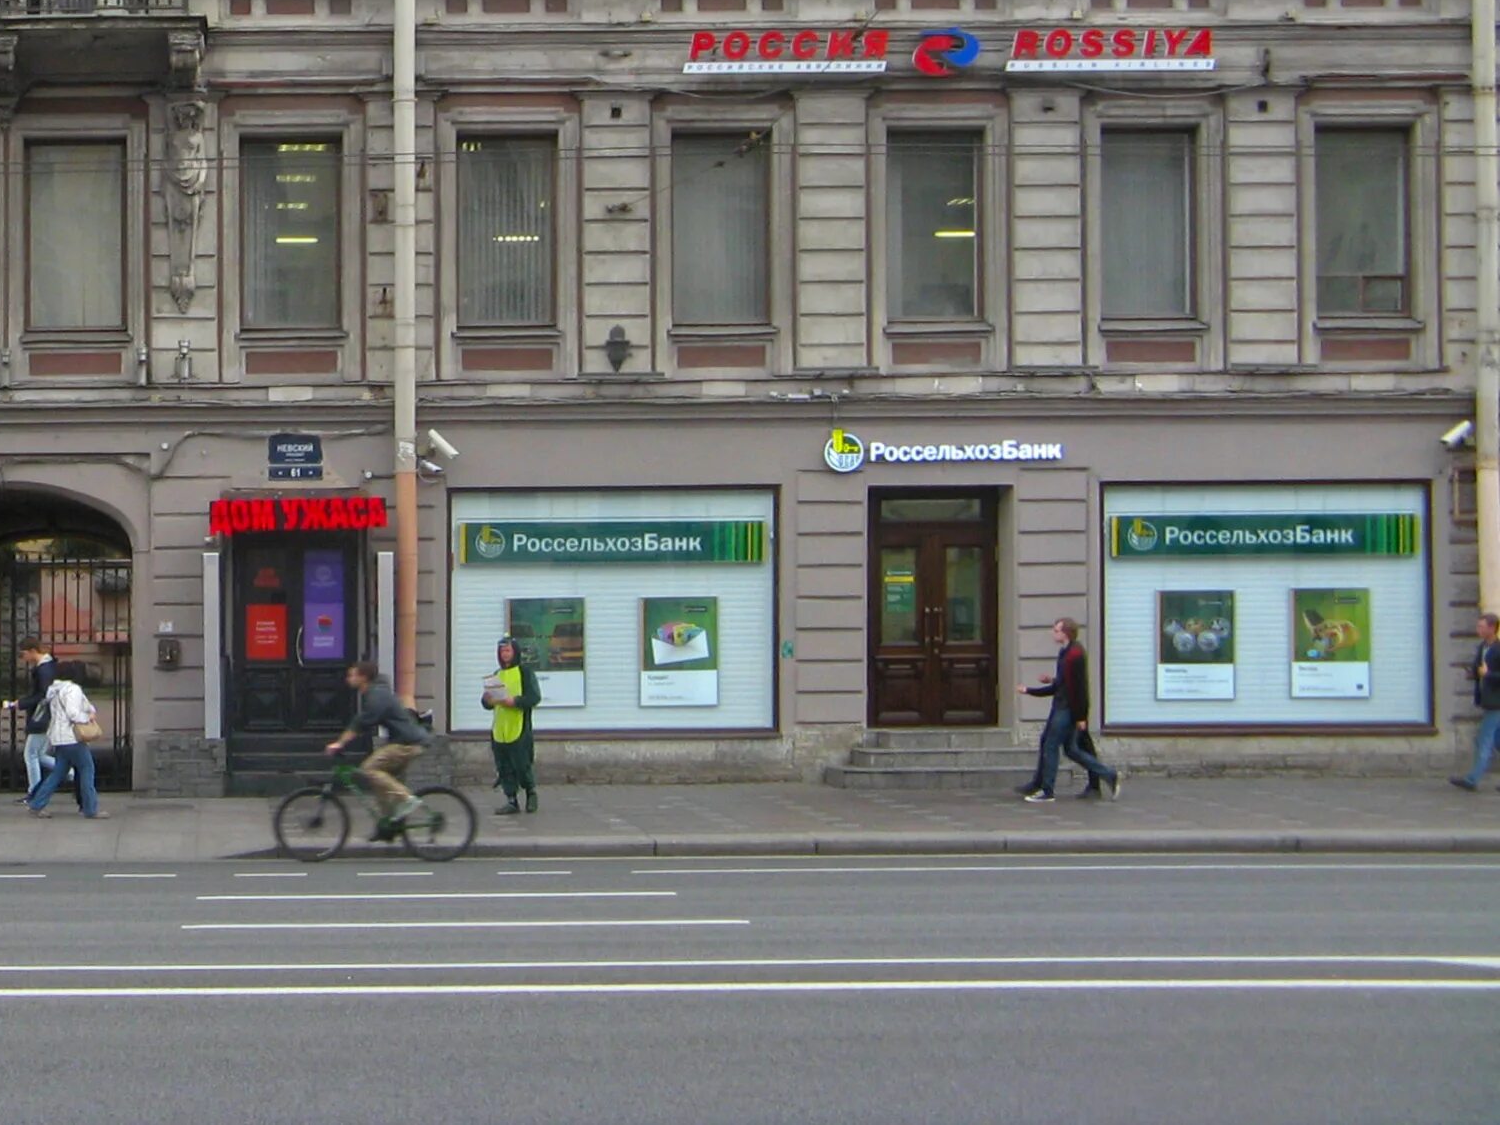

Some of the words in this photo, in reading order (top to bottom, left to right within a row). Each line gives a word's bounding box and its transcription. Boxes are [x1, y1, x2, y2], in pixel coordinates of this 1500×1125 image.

[689, 29, 890, 62] РОССИЯ
[1010, 27, 1213, 60] ROSSIYA
[686, 63, 784, 72] РОССИЙСКИЕ
[1009, 62, 1098, 70] RUSSIAN
[1113, 61, 1212, 69] AIRLINES
[276, 443, 314, 453] НЕВСКИЙ
[870, 440, 1063, 462] РоссельхозБанк
[290, 467, 301, 477] 61
[209, 498, 277, 537] ДОМ
[281, 496, 388, 531] УЖАСА
[512, 532, 702, 553] РоссельхозБанк
[1164, 525, 1354, 545] РоссельхозБанк
